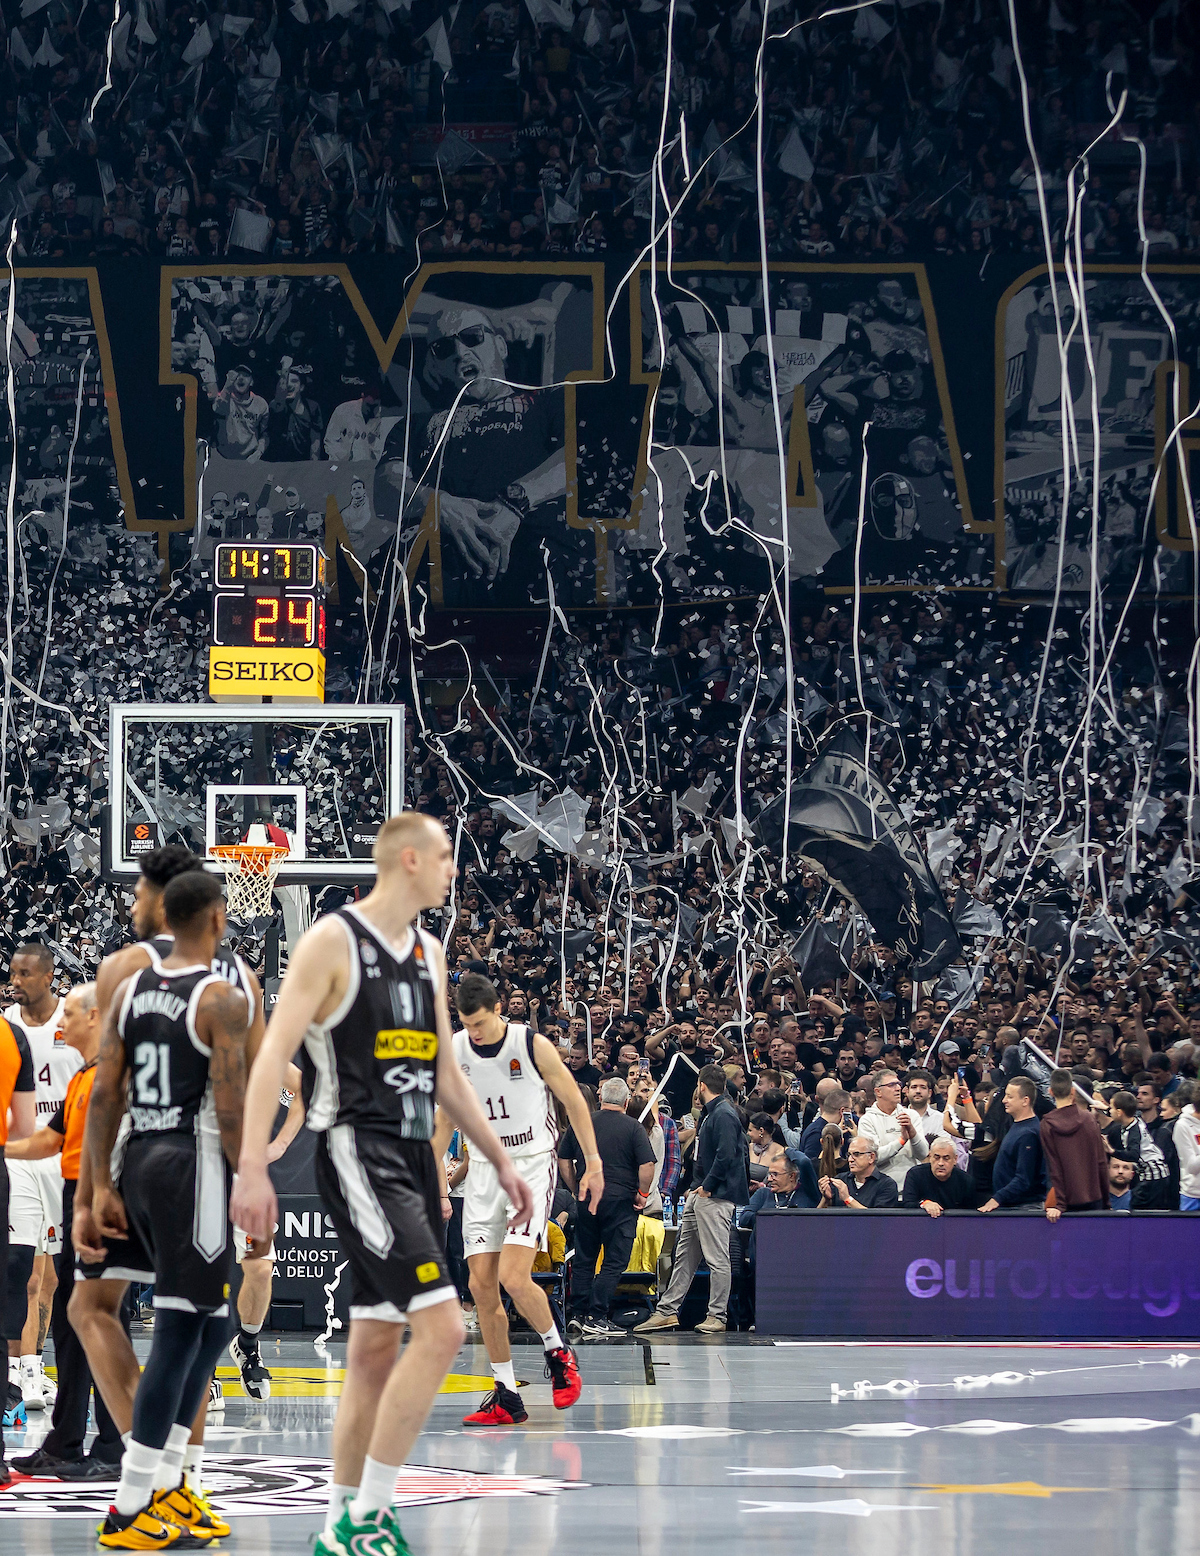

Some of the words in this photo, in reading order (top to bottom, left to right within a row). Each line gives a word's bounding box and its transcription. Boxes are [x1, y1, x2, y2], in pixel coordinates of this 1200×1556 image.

[213, 661, 314, 682] SEIKO
[134, 1041, 172, 1107] 21
[485, 1095, 510, 1121] 11
[276, 1246, 339, 1263] UĆNOST
[271, 1266, 282, 1278] A
[286, 1266, 324, 1278] DELU
